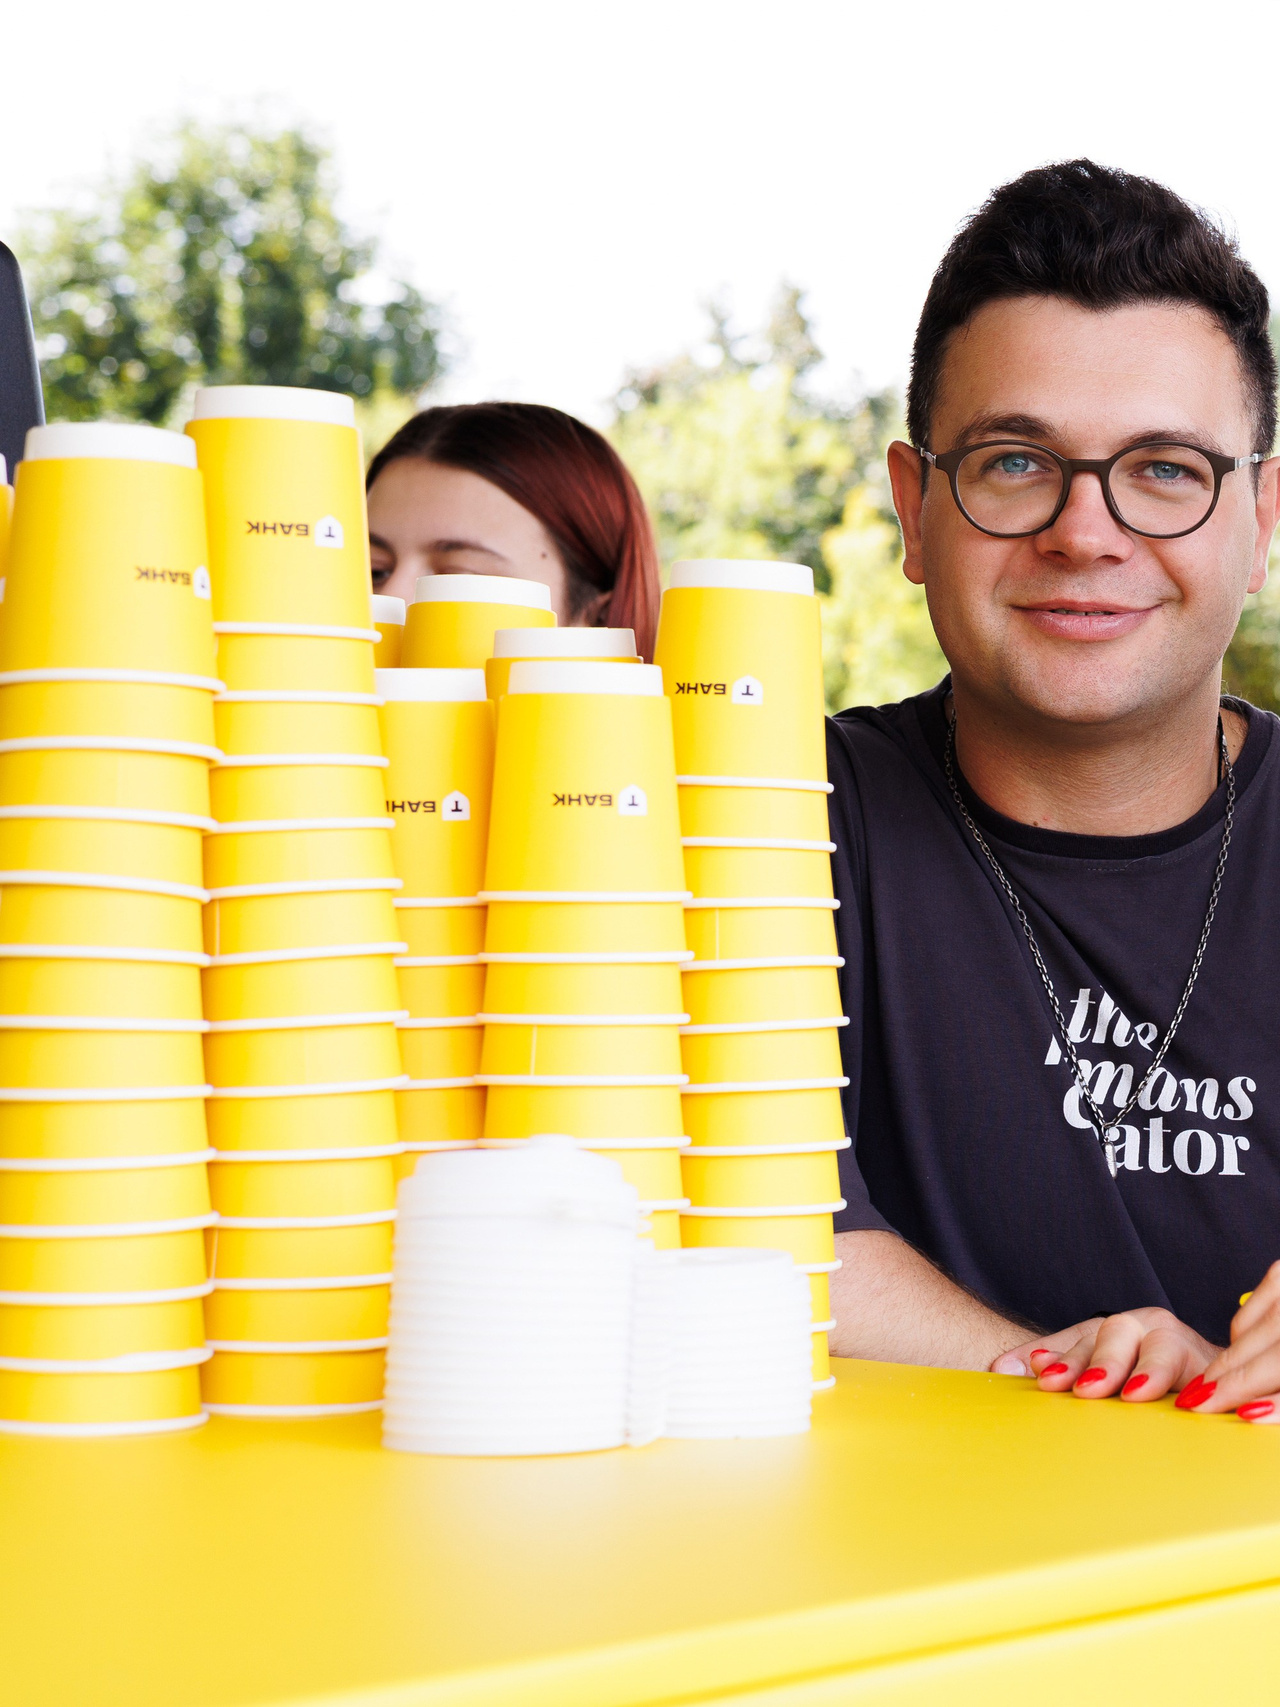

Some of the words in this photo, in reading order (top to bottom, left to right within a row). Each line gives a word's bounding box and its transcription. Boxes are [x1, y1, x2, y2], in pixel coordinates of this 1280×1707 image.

[246, 521, 309, 536] БАНК
[136, 566, 192, 586] БАНК
[675, 682, 726, 695] БАНК
[553, 794, 613, 806] БАНК
[386, 801, 436, 813] БАН
